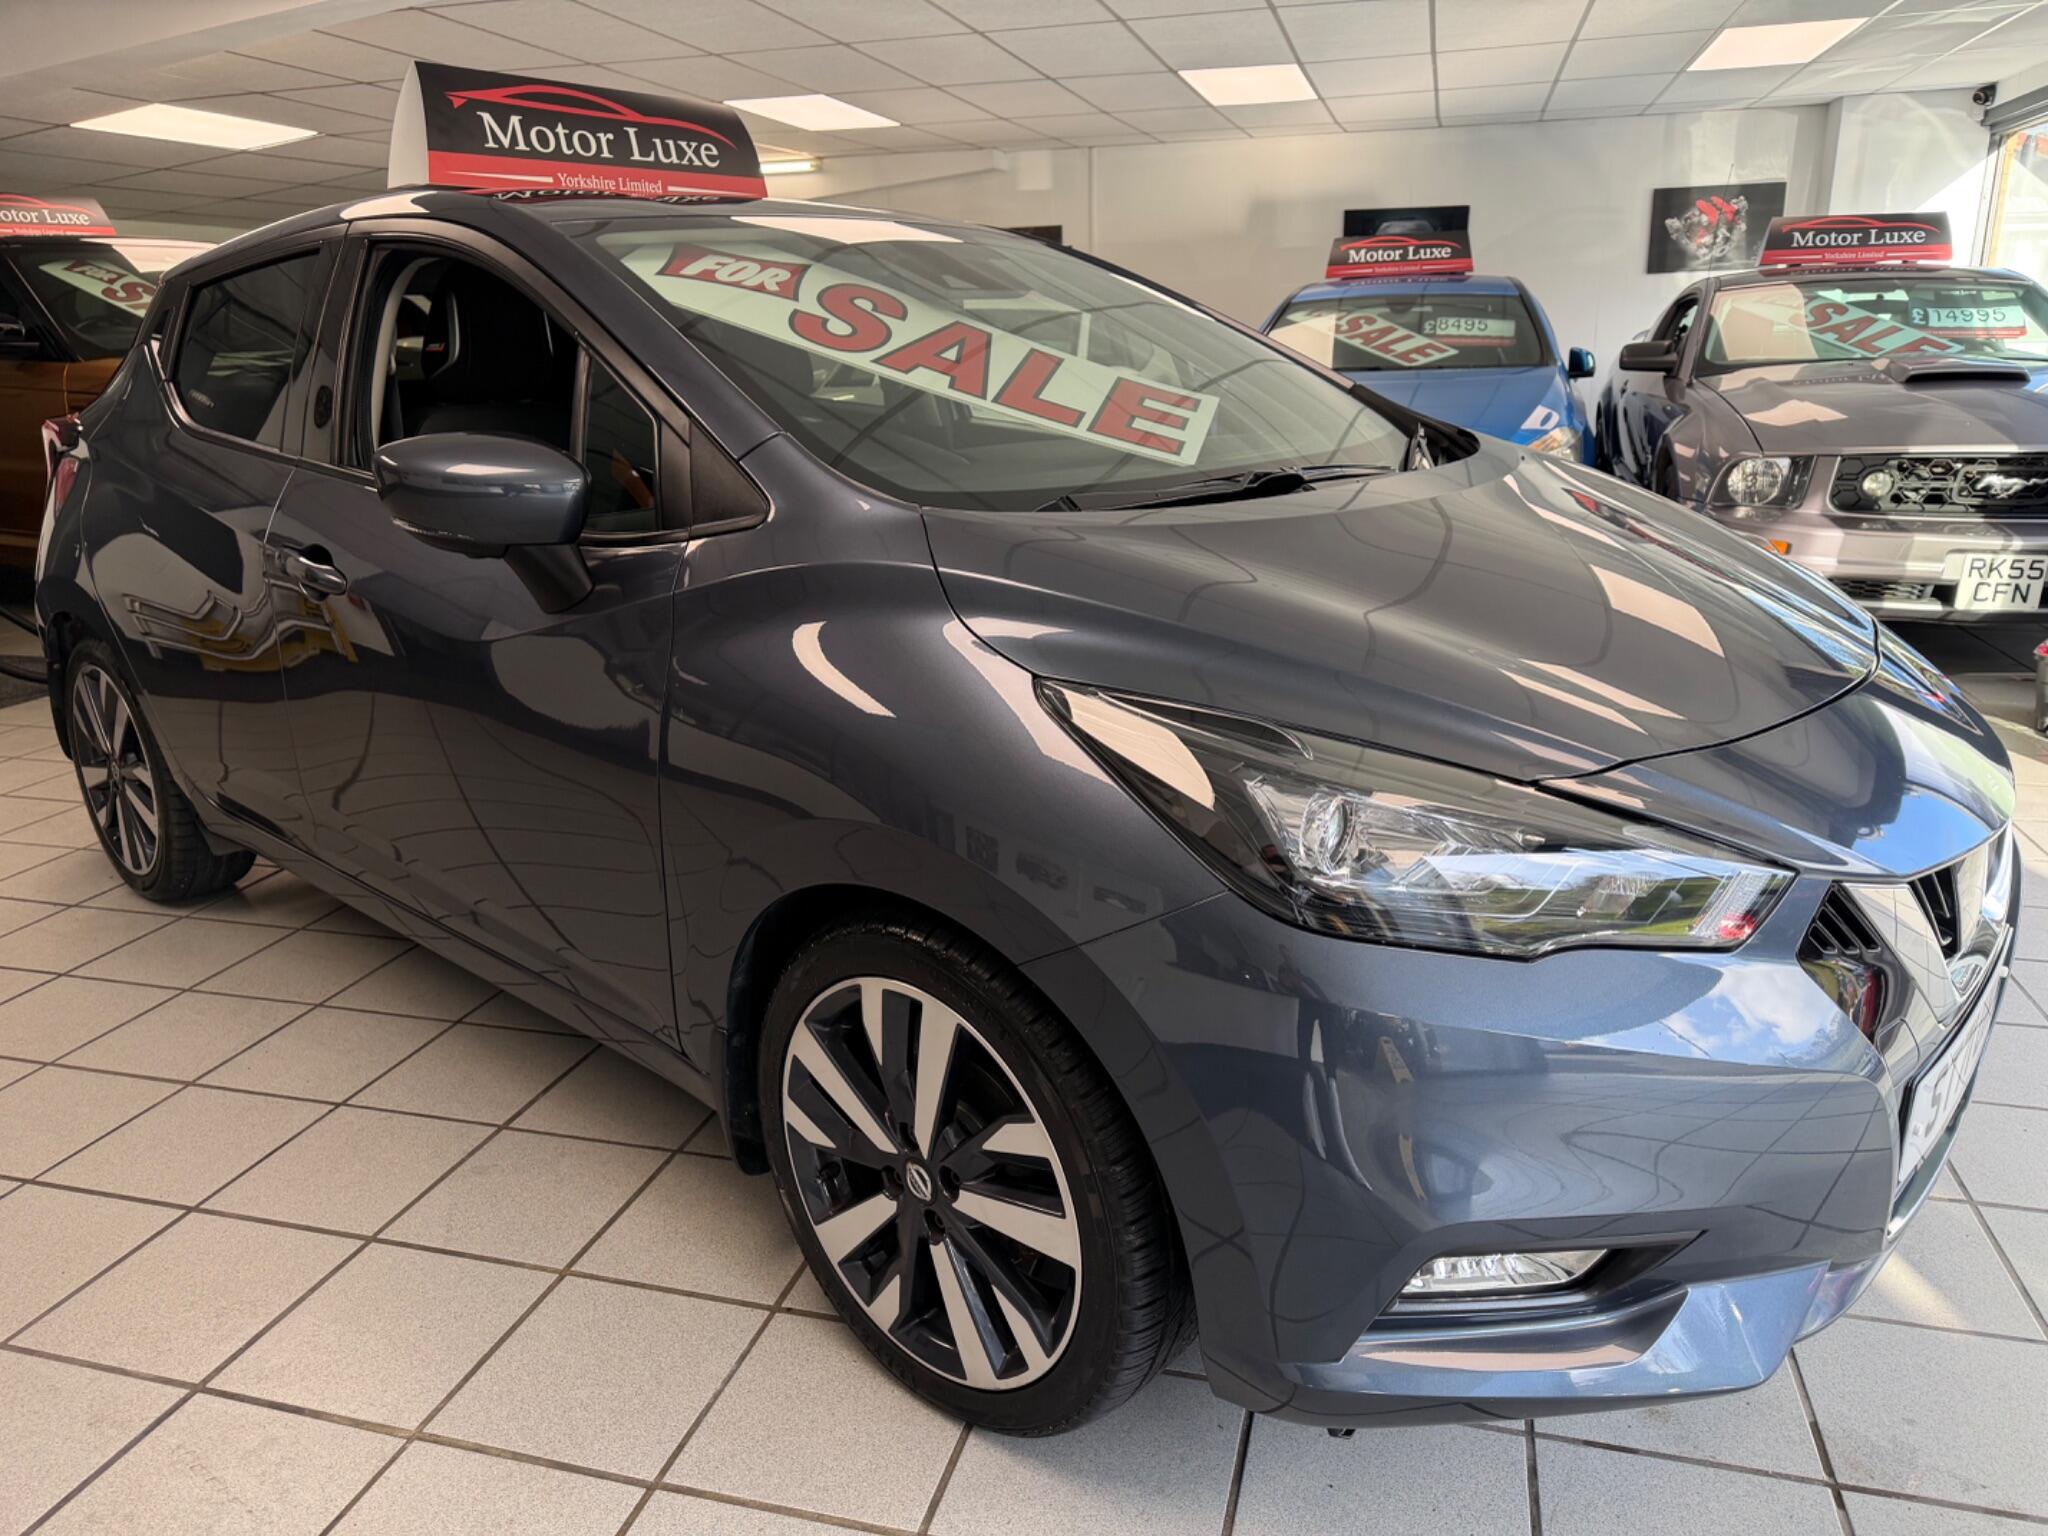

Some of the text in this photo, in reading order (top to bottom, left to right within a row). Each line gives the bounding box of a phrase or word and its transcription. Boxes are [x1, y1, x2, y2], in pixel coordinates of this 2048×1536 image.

[476, 111, 720, 168] Motor Luxe
[557, 173, 616, 191] Yorkshire
[619, 177, 663, 193] Limited
[0, 208, 91, 225] otor Luxe
[1791, 230, 1927, 248] Motor Luxe
[1348, 246, 1452, 264] Motor Luxe
[679, 252, 795, 292] FOR
[1424, 318, 1488, 334] £8495
[1911, 306, 2007, 325] £14995
[1335, 314, 1449, 364] SALE
[789, 283, 1202, 457] SALE
[1968, 557, 2045, 580] RK55
[1973, 581, 2031, 603] CFN
